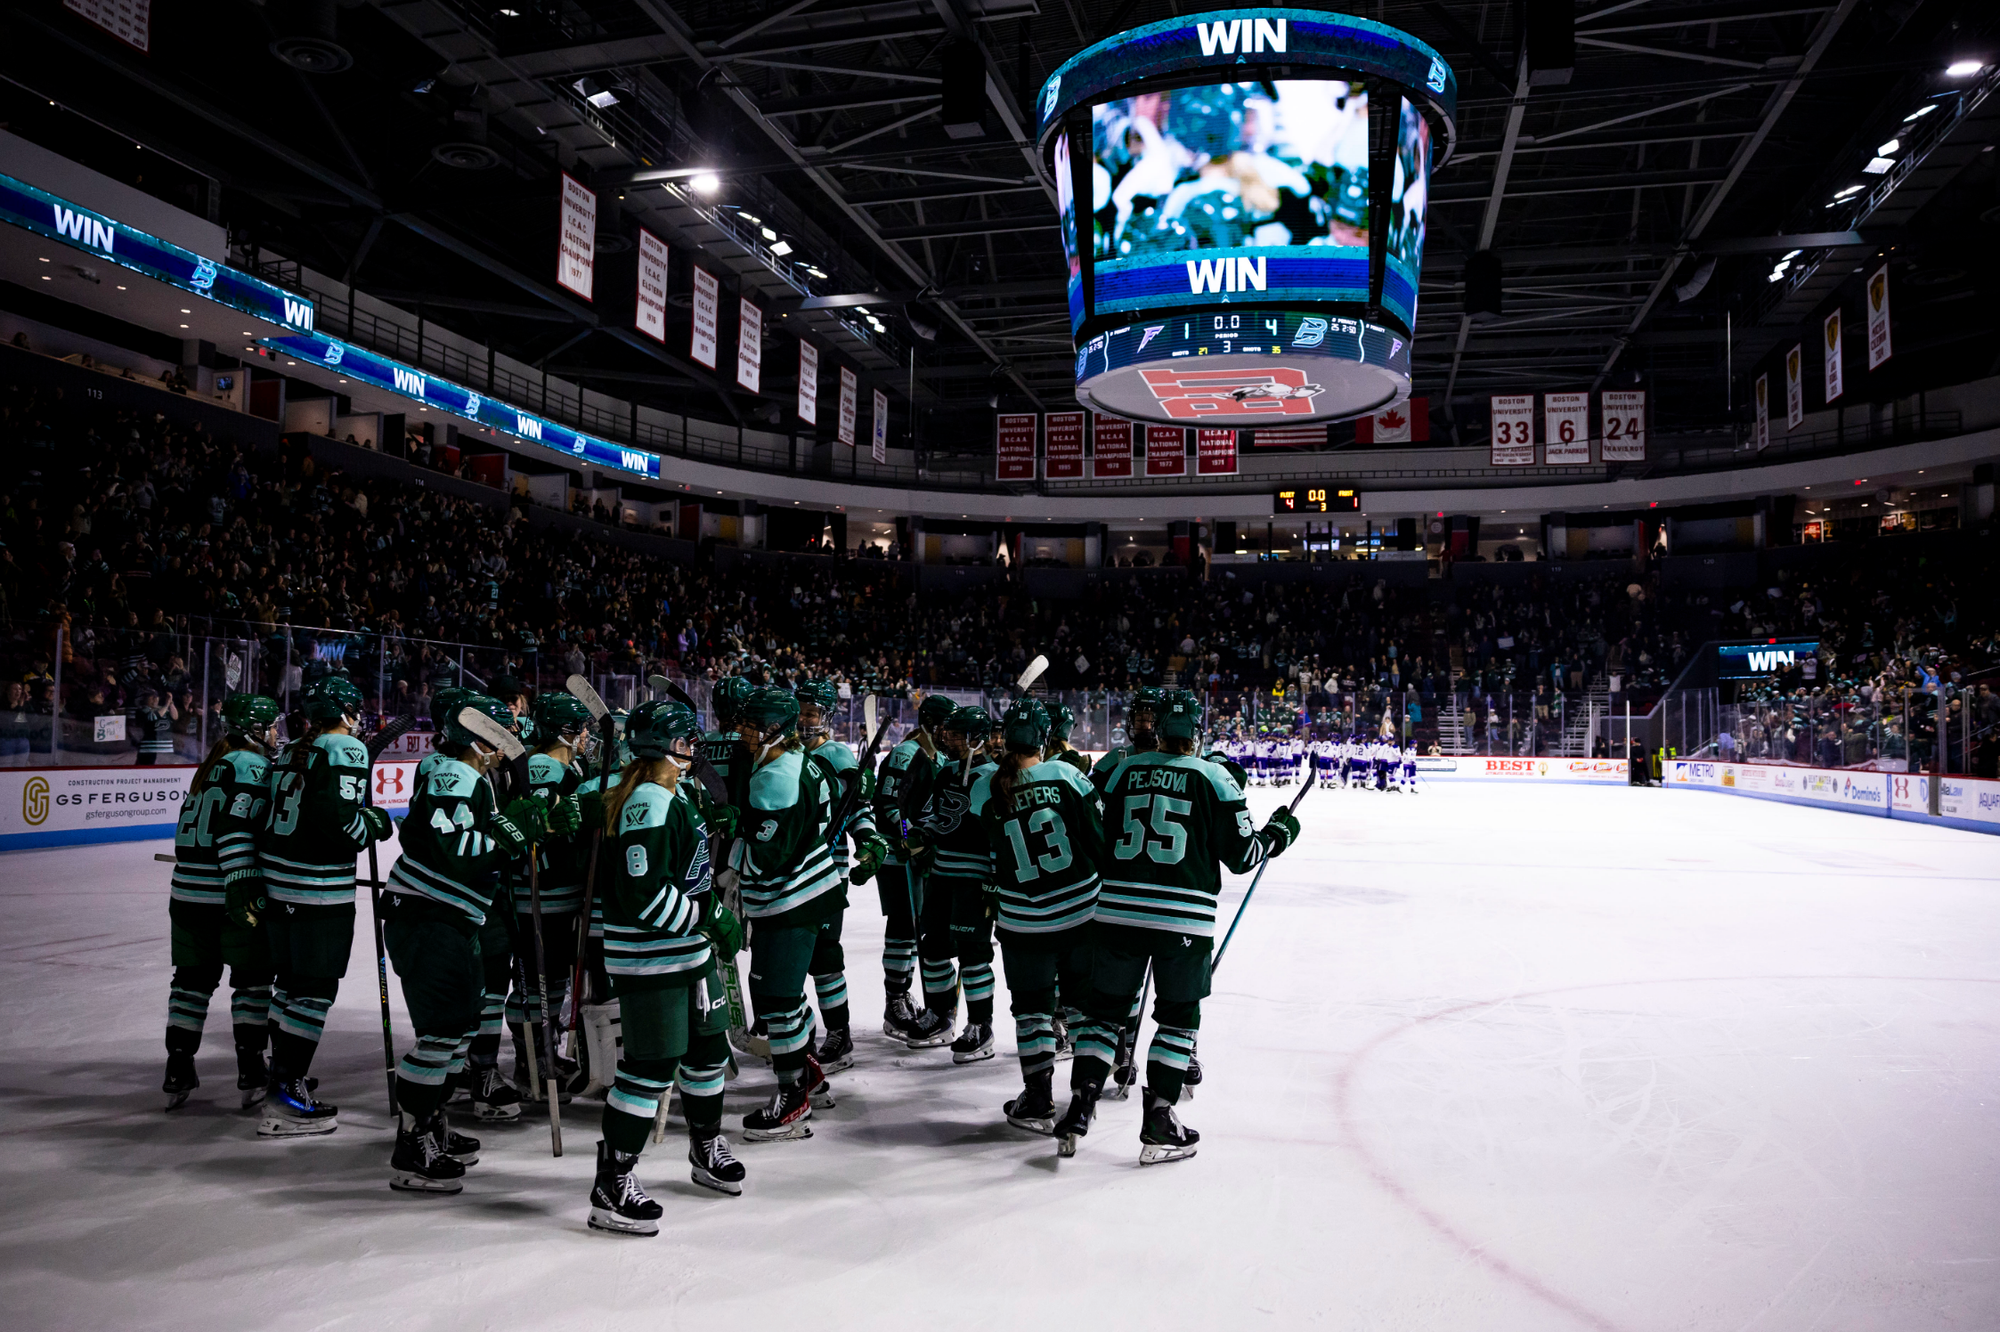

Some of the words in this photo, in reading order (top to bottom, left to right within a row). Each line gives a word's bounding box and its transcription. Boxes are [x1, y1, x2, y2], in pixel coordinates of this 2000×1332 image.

[1196, 18, 1287, 57] WIN
[568, 181, 590, 203] BOSTON
[564, 196, 594, 222] UNIVERSITY
[53, 203, 114, 254] WIN
[565, 229, 590, 252] EASTERN
[562, 244, 593, 268] CHAMPION
[1186, 256, 1267, 294] WIN
[284, 298, 313, 331] WI
[1214, 315, 1240, 329] 0.0
[1184, 321, 1189, 340] 1
[1265, 318, 1277, 336] 4
[1222, 340, 1231, 353] 3
[393, 367, 425, 398] WIN
[517, 414, 542, 440] WIN
[1497, 421, 1529, 444] 33
[1559, 419, 1575, 443] 6
[1607, 417, 1640, 440] 24
[1148, 450, 1184, 458] CHAMPIONS
[1150, 440, 1180, 448] NATIONAL
[1200, 448, 1236, 456] CHAMPIONS
[620, 450, 648, 473] WIN
[1095, 452, 1130, 460] CHAMPIONS
[1286, 498, 1294, 509] 4
[1320, 502, 1326, 512] 3
[1354, 497, 1358, 508] 1
[1747, 650, 1795, 672] WIN
[1172, 704, 1184, 713] 55
[406, 736, 420, 752] BU
[1485, 760, 1535, 771] BEST
[1689, 763, 1714, 778] METRO
[1128, 768, 1188, 794] PEJŠOVÁ
[1940, 783, 1963, 797] ellaLaw
[56, 794, 82, 806] GS
[1852, 785, 1881, 802] Domino's
[86, 807, 167, 821] gsfergusongroup.com
[175, 786, 228, 847] 20
[430, 800, 475, 834] 44
[1235, 809, 1253, 838] 5
[756, 818, 779, 842] 3
[1114, 793, 1192, 865] 55
[1003, 807, 1074, 884] 13
[626, 844, 649, 878] 8
[538, 974, 548, 1018] BAUER
[712, 995, 726, 1010] CC
[780, 1101, 808, 1125] CCM
